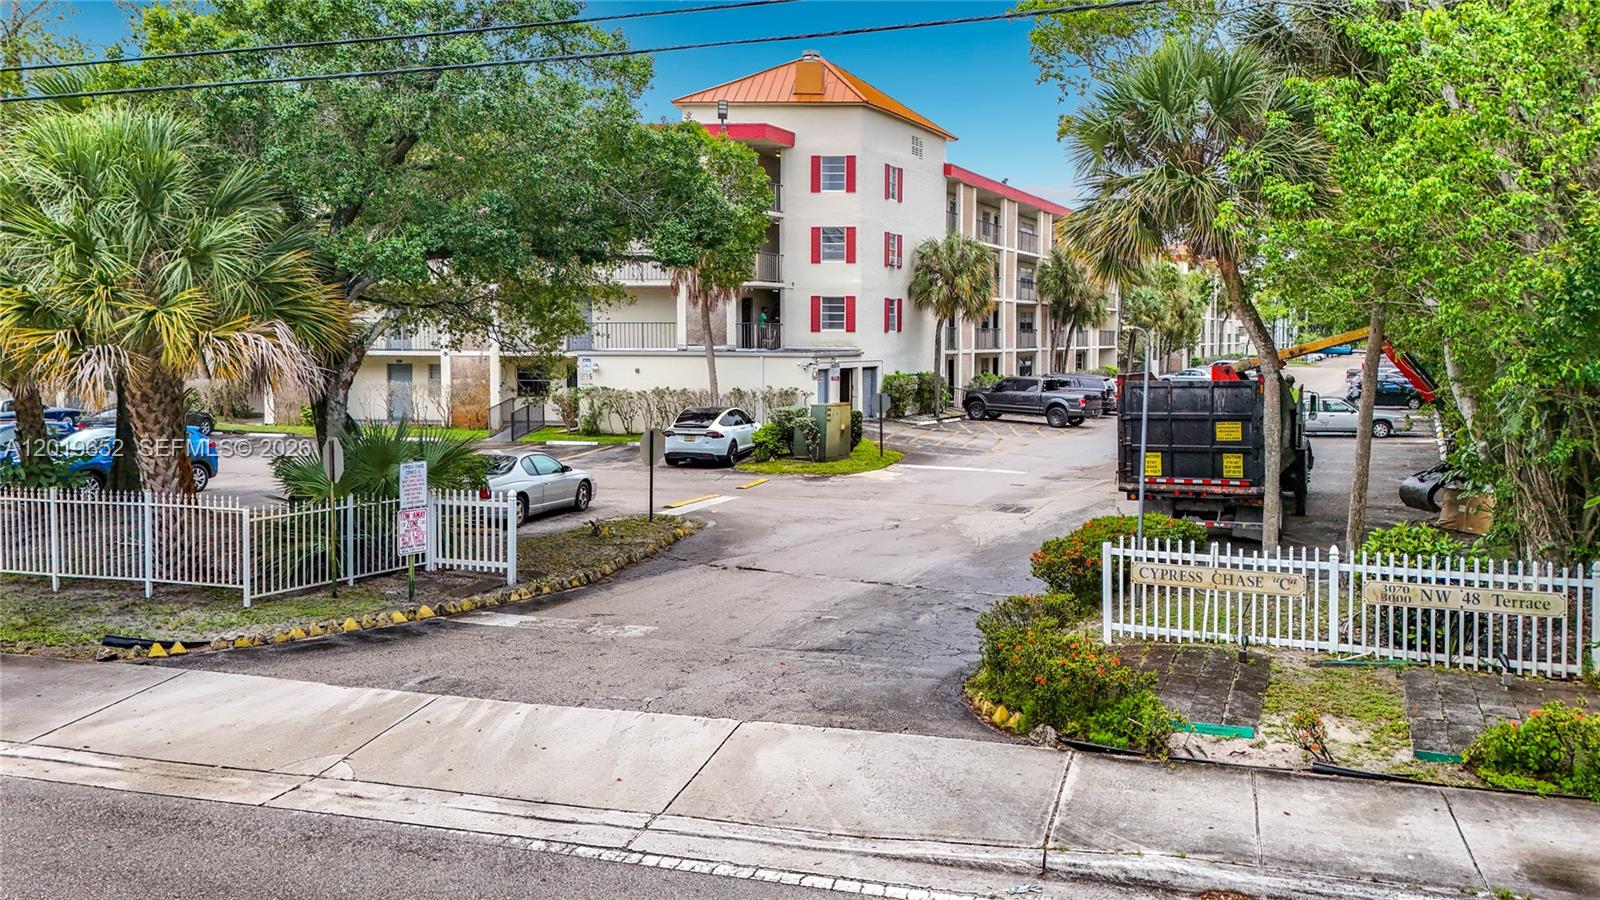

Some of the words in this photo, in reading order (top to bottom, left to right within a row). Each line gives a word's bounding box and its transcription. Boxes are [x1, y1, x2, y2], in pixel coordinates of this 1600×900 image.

[400, 512, 410, 520] TOW
[413, 510, 426, 519] AWAY
[406, 519, 420, 529] ZONE
[1139, 566, 1204, 584] CYPRESS
[1211, 572, 1265, 589] CHASE
[1380, 584, 1410, 594] 3070
[1420, 588, 1452, 604] NW
[1461, 591, 1481, 606] 48
[1491, 593, 1552, 611] Terrace
